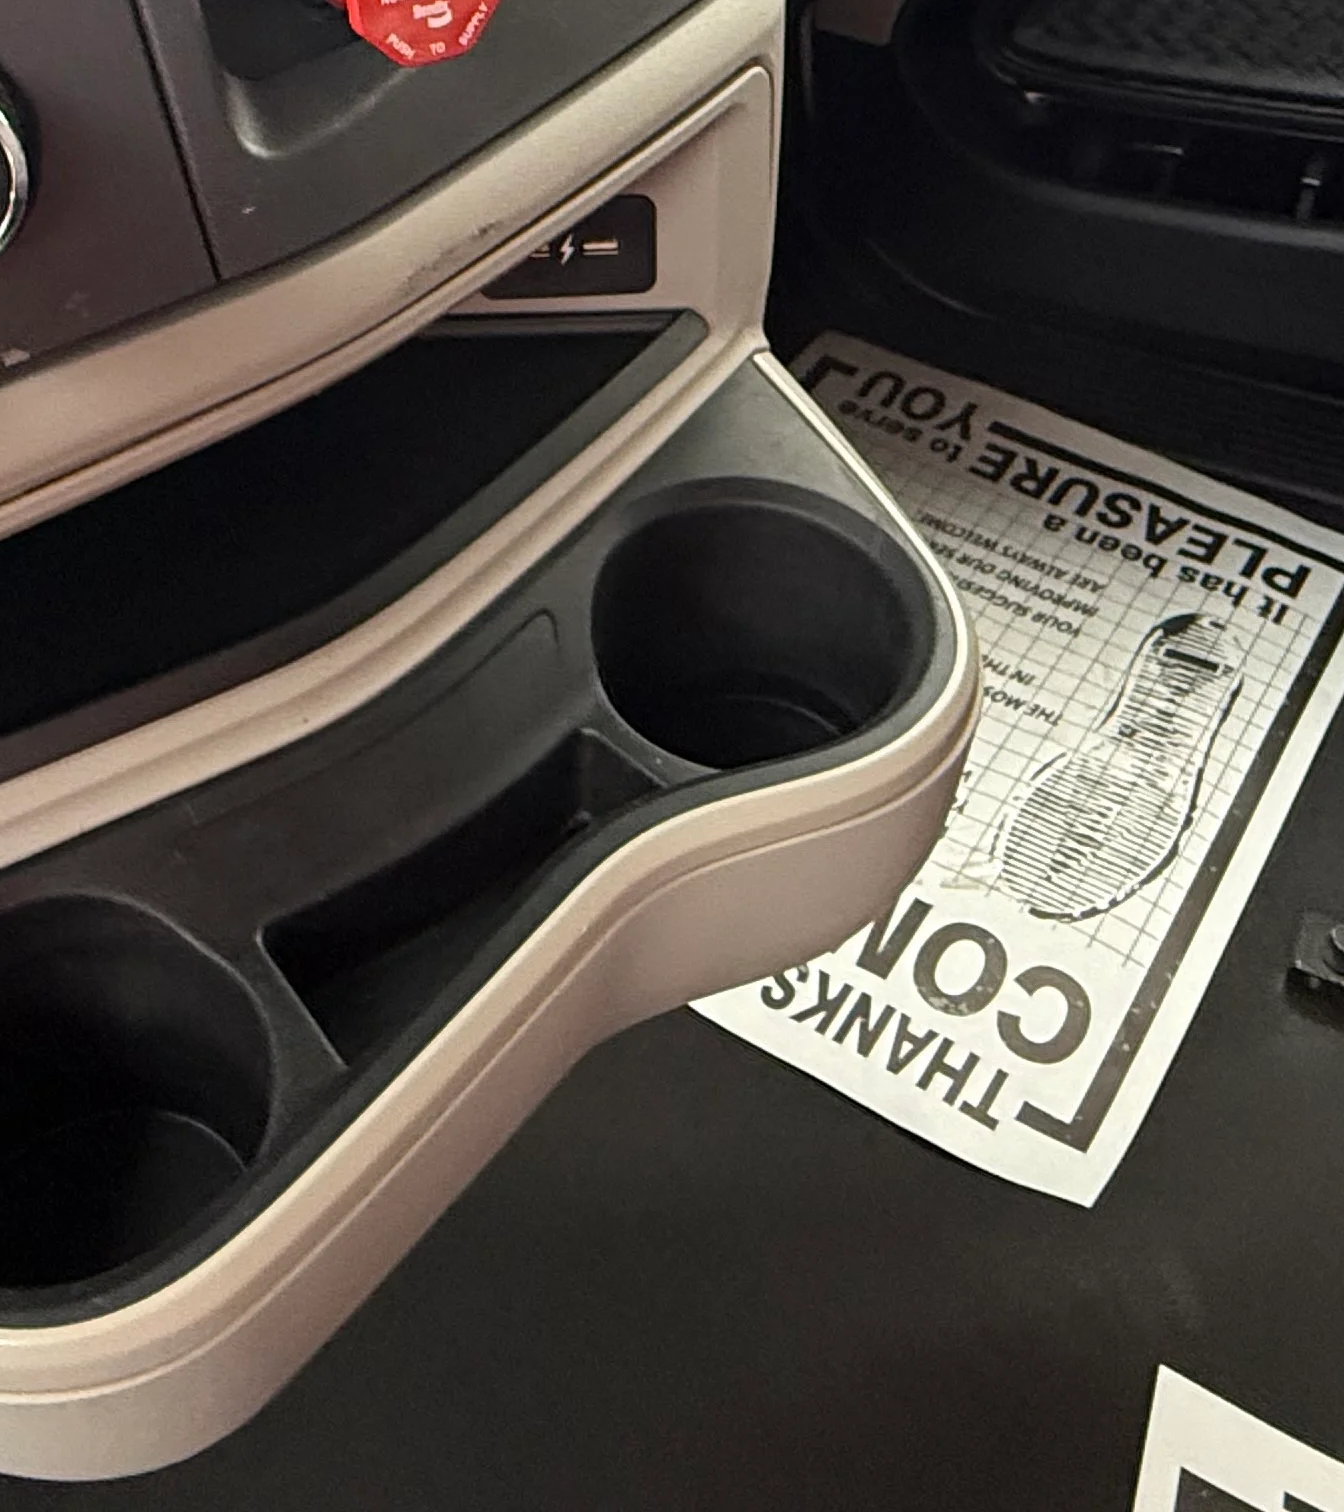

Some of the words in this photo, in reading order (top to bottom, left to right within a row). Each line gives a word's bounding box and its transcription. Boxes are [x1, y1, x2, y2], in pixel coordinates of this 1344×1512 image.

[386, 32, 416, 60] PUSH
[429, 41, 446, 56] TO
[458, 1, 489, 47] SUPPLY
[838, 398, 924, 443] serve
[857, 370, 979, 442] YOU
[930, 438, 963, 463] to
[968, 441, 1313, 601] PLEASURE
[1043, 512, 1067, 533] a
[956, 552, 996, 576] OUR
[1003, 545, 1070, 580] ALWAYS
[1075, 524, 1169, 579] been
[950, 573, 1033, 617] SUGGEST
[995, 569, 1100, 618] IMPROVING
[1070, 569, 1106, 594] ARE
[1177, 564, 1251, 608] has
[1031, 609, 1081, 639] YOUR
[1254, 592, 1291, 626] It
[1009, 667, 1036, 687] IN
[1023, 704, 1064, 727] THE
[760, 963, 1011, 1132] THANKS
